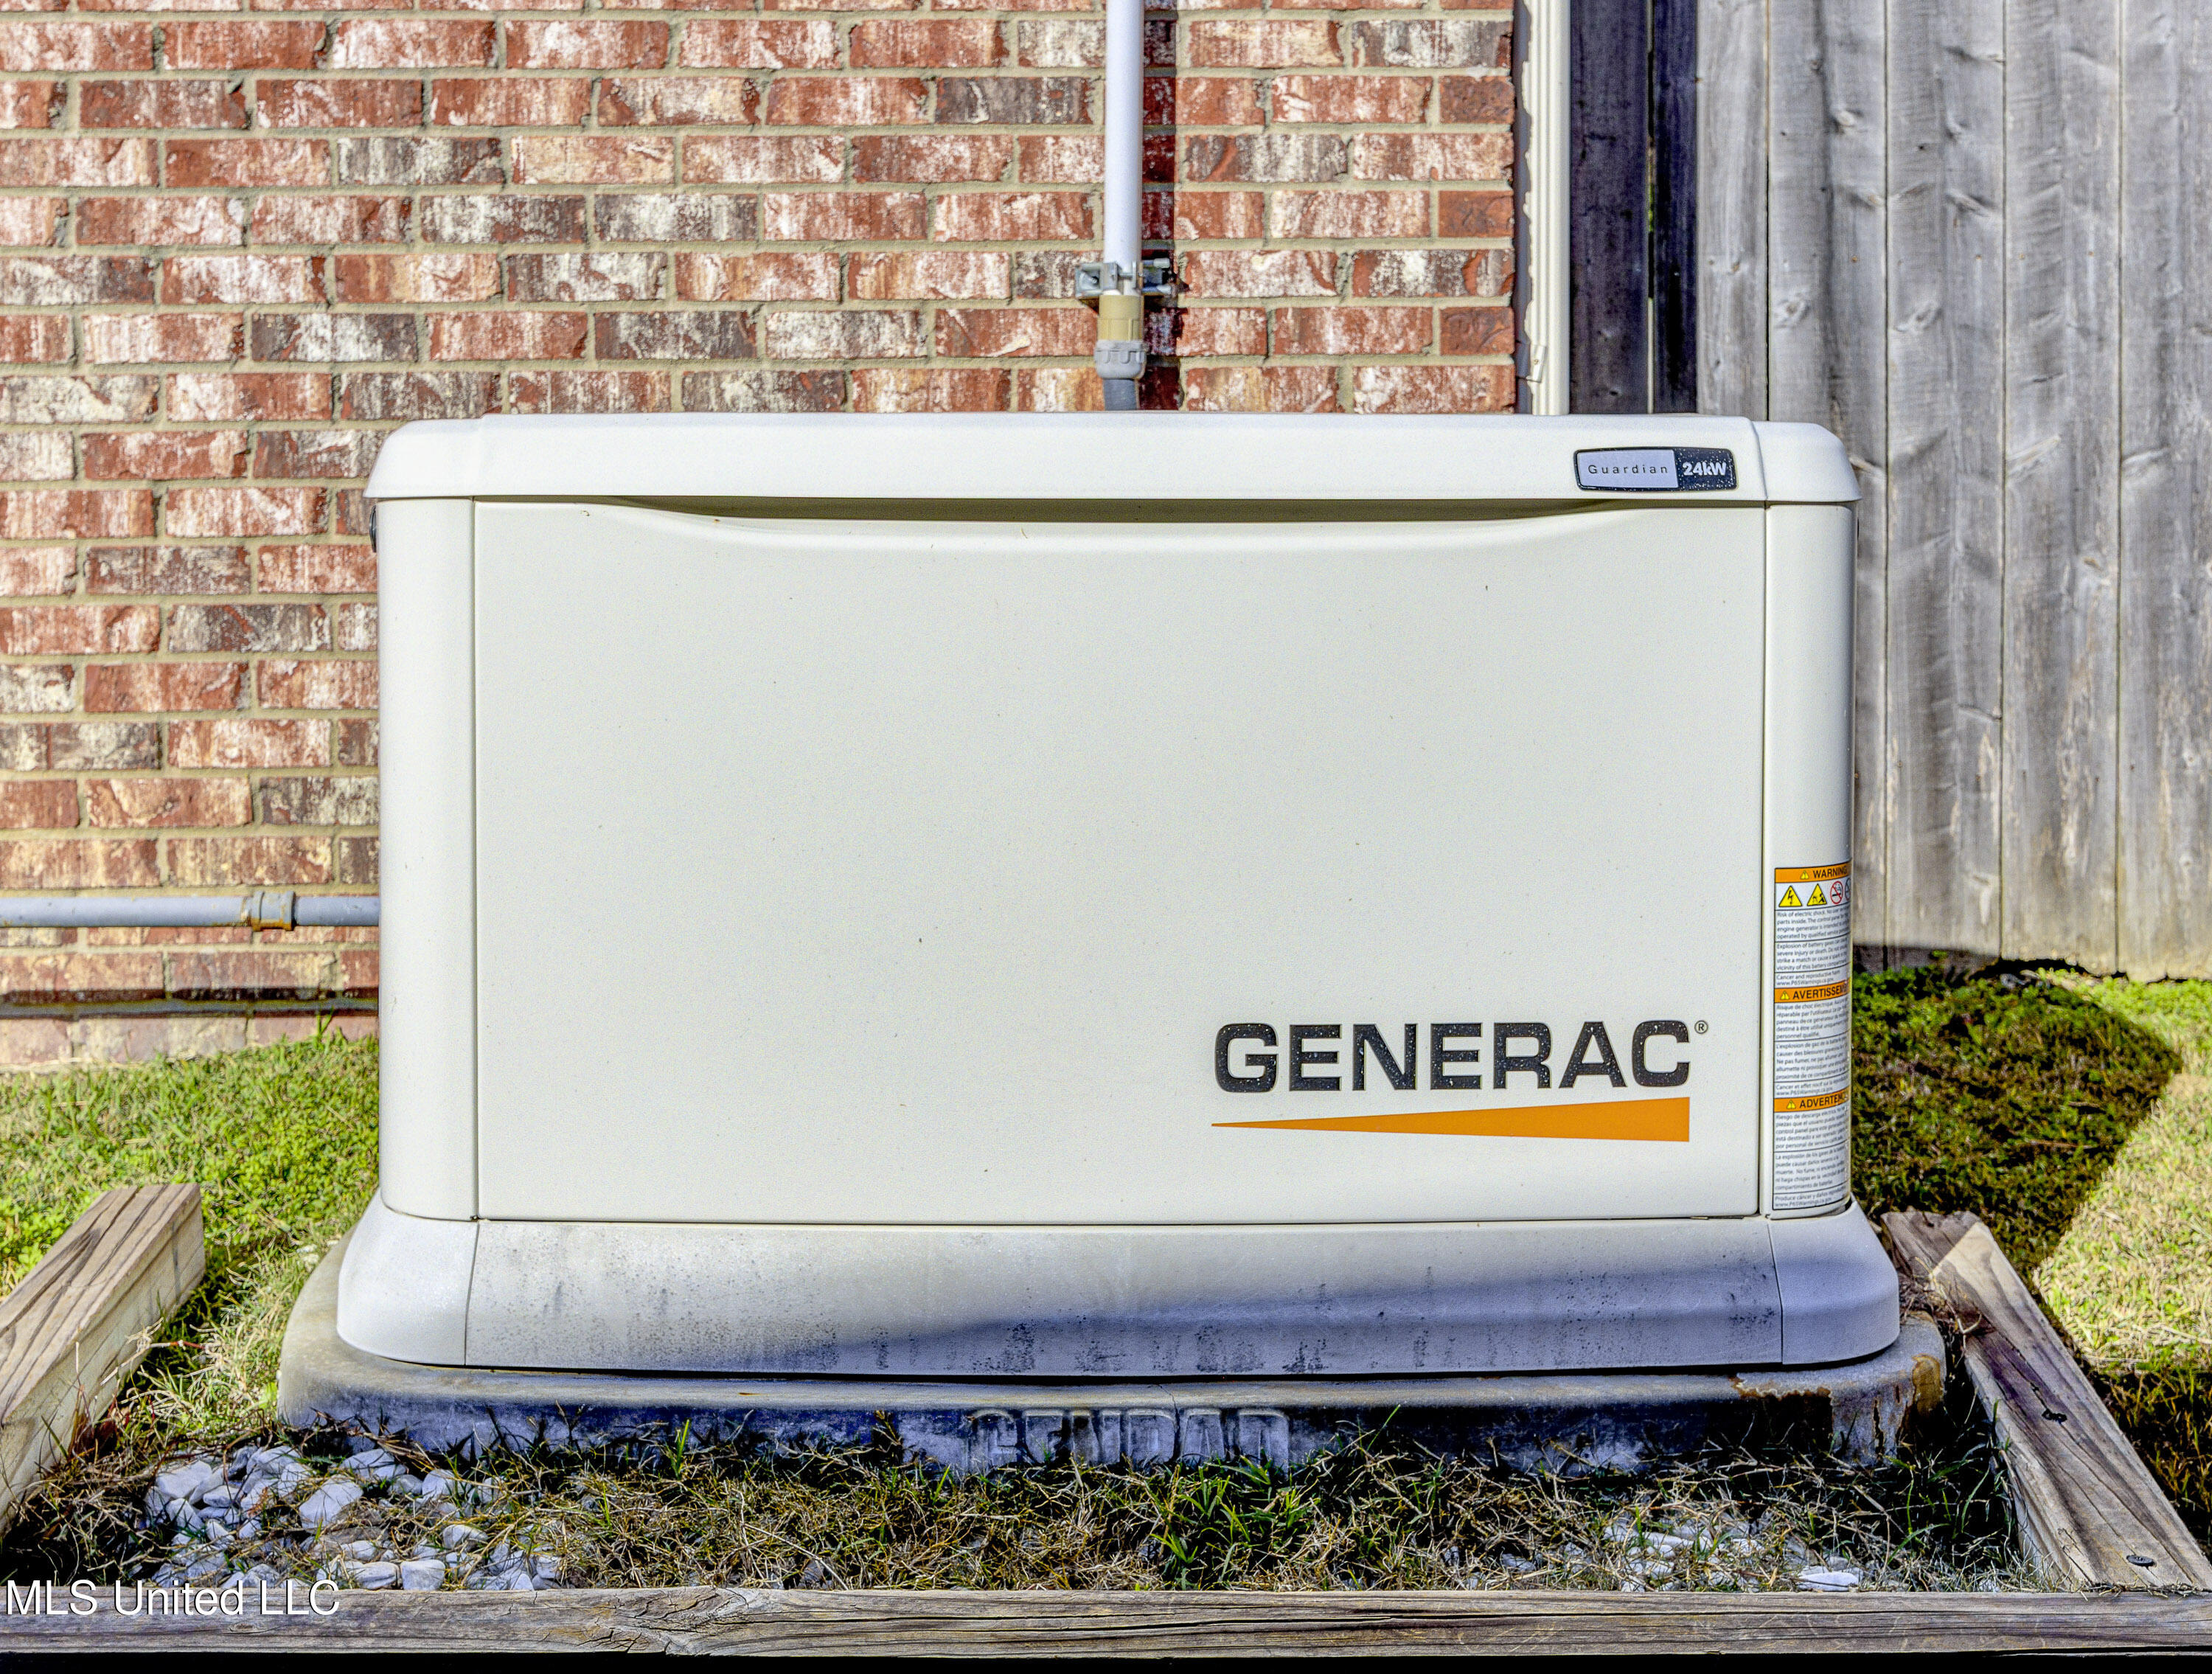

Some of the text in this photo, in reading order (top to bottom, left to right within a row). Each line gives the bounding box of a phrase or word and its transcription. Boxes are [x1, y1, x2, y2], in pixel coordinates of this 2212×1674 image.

[1587, 462, 1728, 476] Guardian 24kW
[1813, 866, 1846, 878] WARNING
[1214, 1020, 1691, 1093] GENERAC
[1800, 1094, 1843, 1108] ADVERTEN
